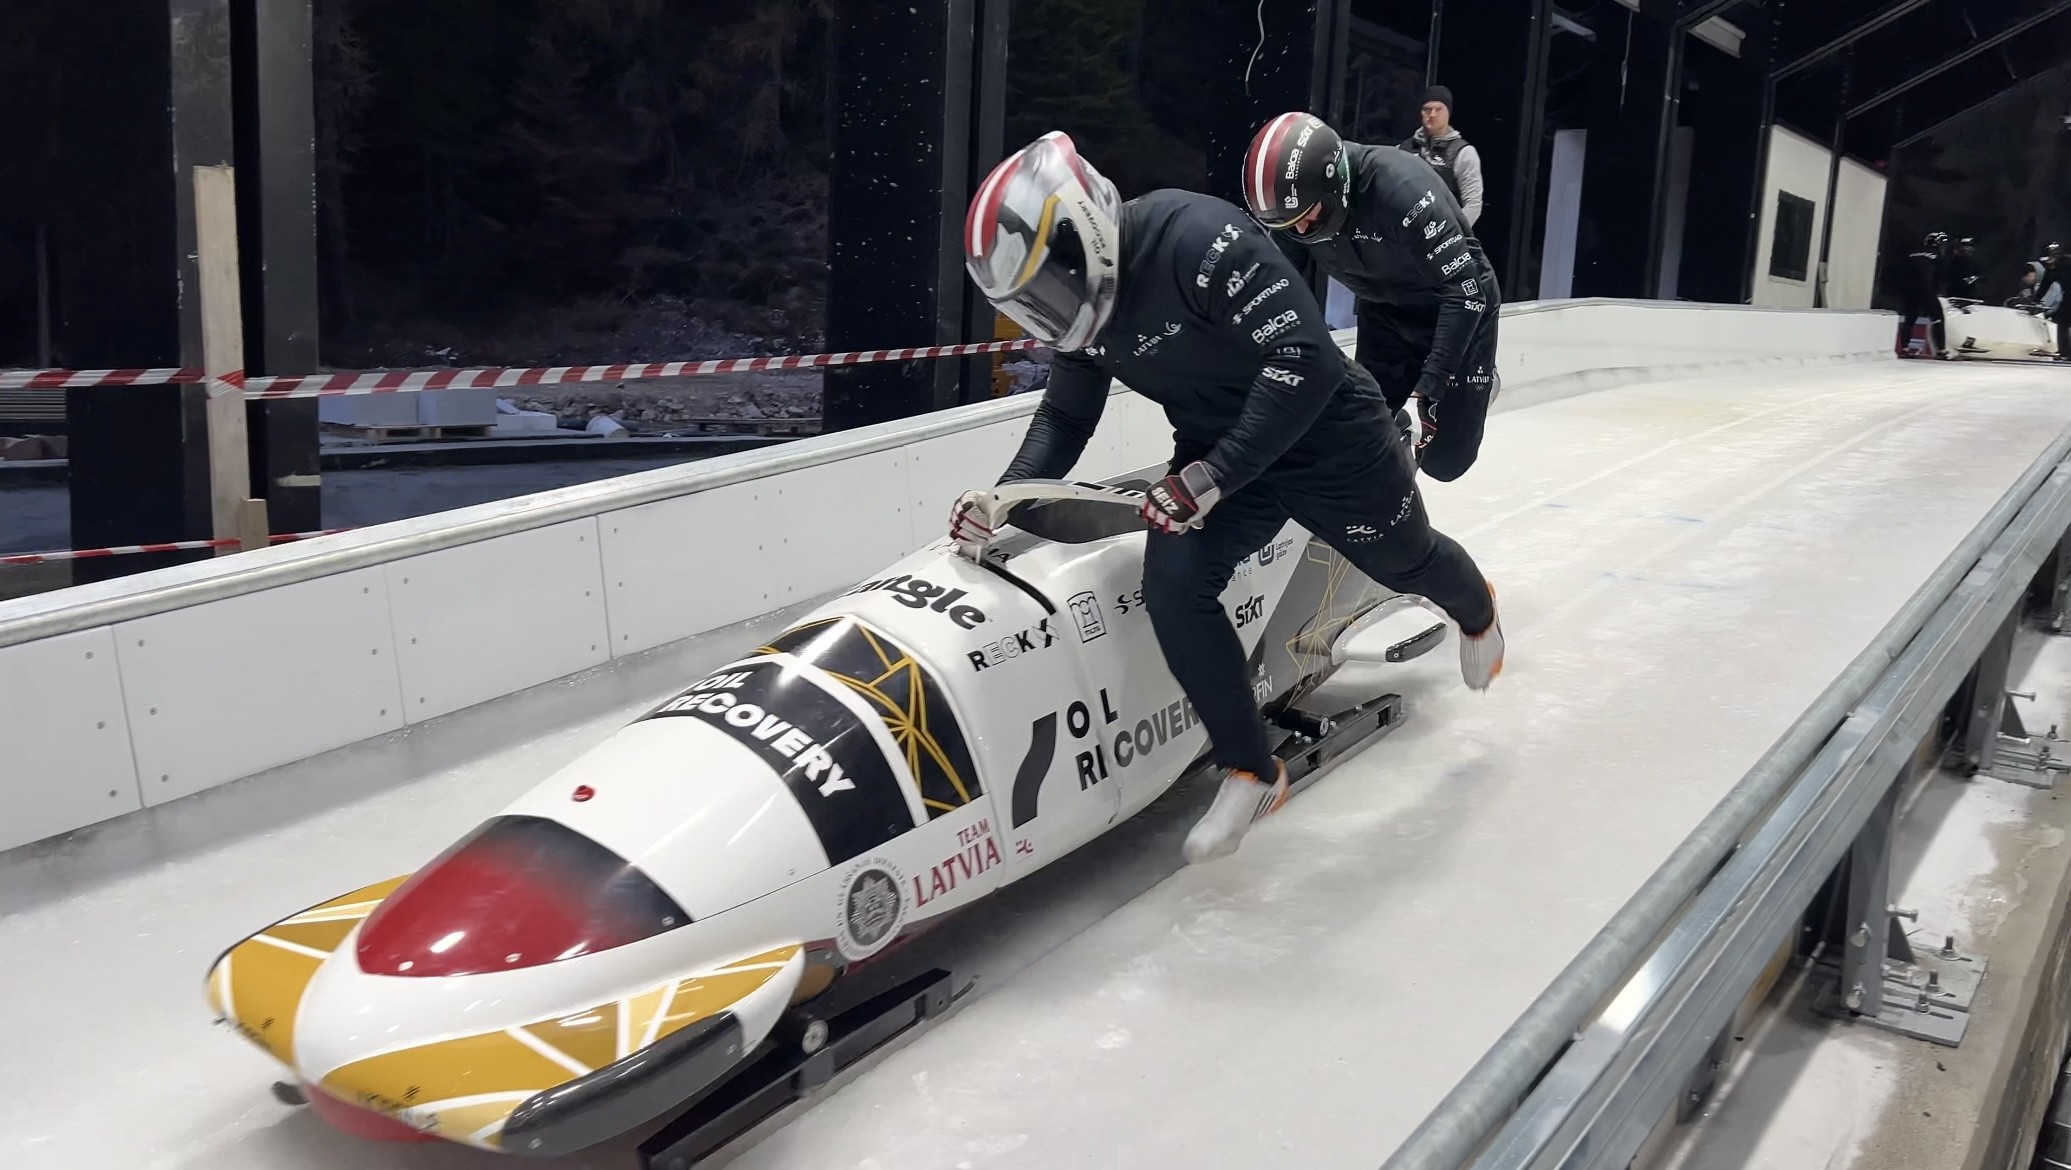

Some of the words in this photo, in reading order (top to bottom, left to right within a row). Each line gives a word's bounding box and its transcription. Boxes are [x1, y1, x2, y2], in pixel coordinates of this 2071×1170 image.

[1285, 148, 1300, 180] Balcia
[1441, 252, 1472, 276] Balcia
[1242, 278, 1290, 316] SPORTLAND
[1251, 309, 1299, 345] Balcia
[1133, 335, 1163, 357] LATVIA
[693, 671, 754, 691] OIL
[655, 691, 857, 798] RECOVERY
[956, 817, 991, 847] TEAM
[911, 836, 1002, 909] LATVIA
